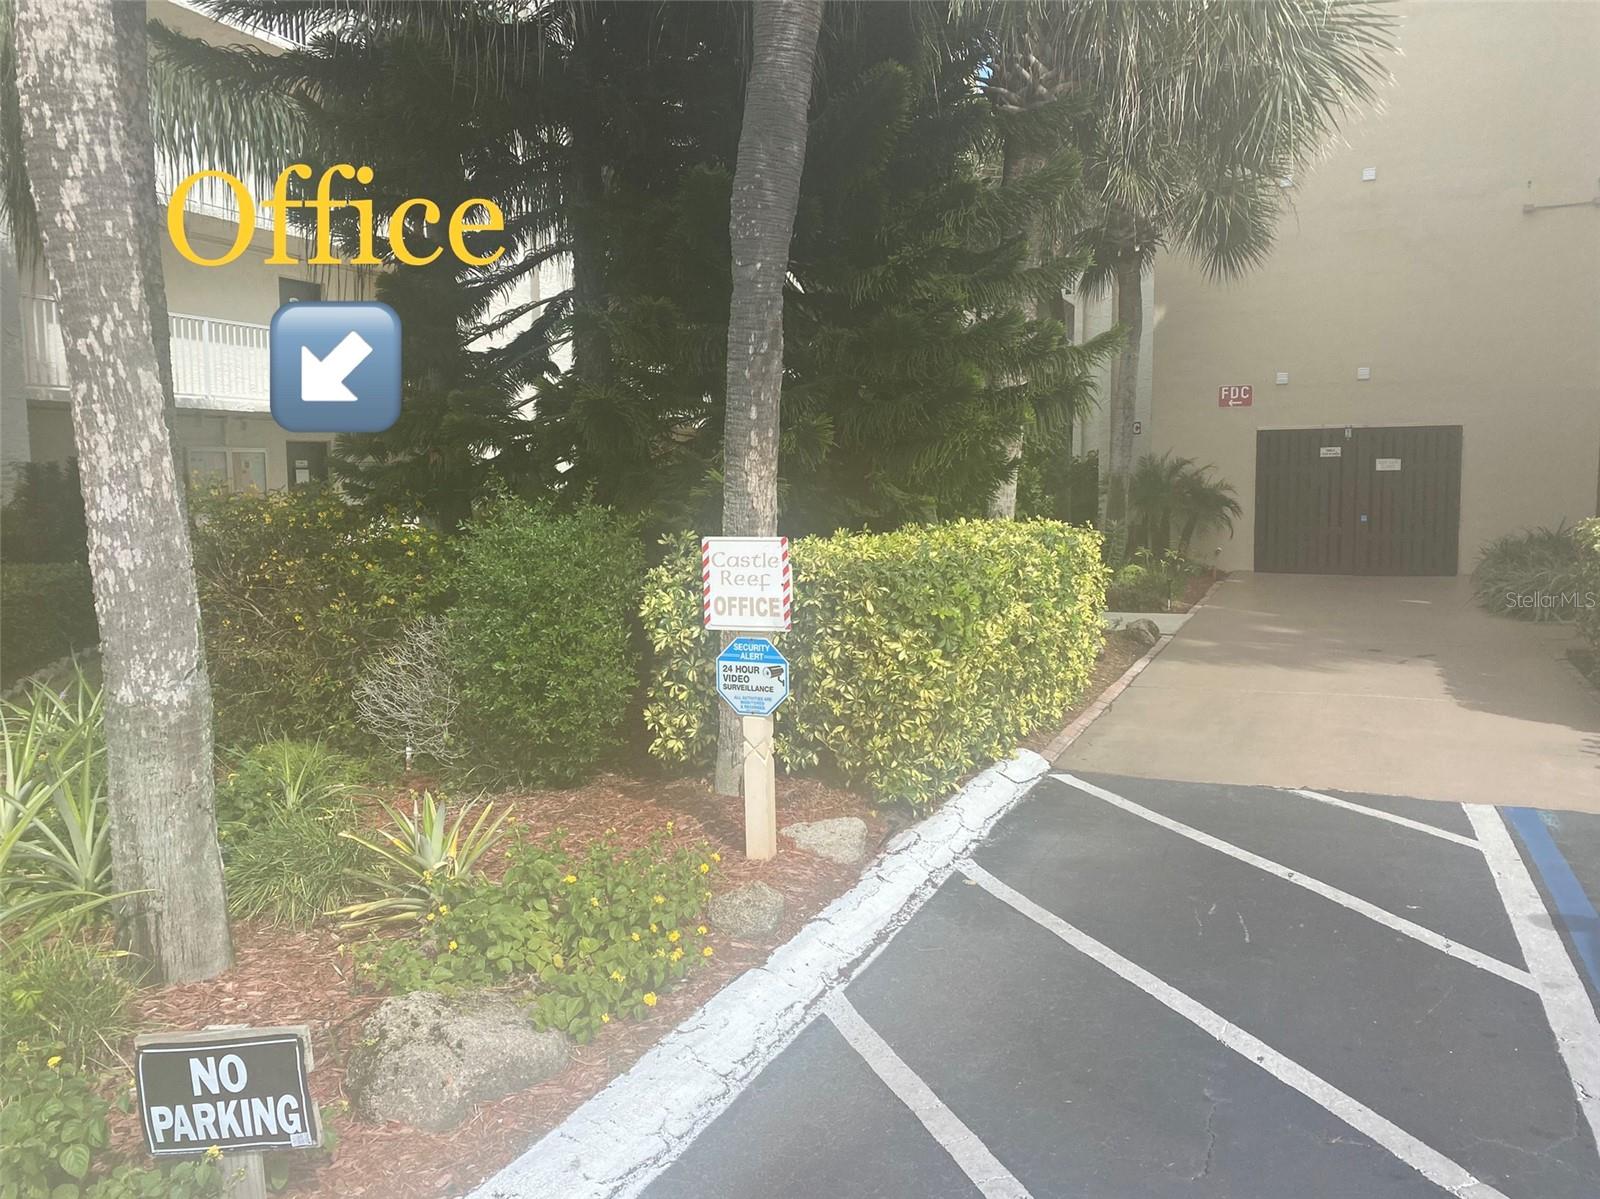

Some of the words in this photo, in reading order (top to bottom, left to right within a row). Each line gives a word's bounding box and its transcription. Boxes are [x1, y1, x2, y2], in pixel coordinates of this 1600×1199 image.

[1221, 386, 1250, 399] FDC
[711, 551, 779, 568] Castle
[720, 569, 771, 592] Reef
[713, 595, 780, 617] OFFICE
[733, 642, 771, 652] SECURITY
[740, 652, 764, 660] ALERT
[722, 665, 733, 673] 24
[735, 665, 760, 674] HOUR
[722, 674, 750, 683] VIDEO
[722, 683, 775, 693] SURVEILLANCE
[189, 1054, 248, 1096] NO
[150, 1094, 302, 1143] PARKING
